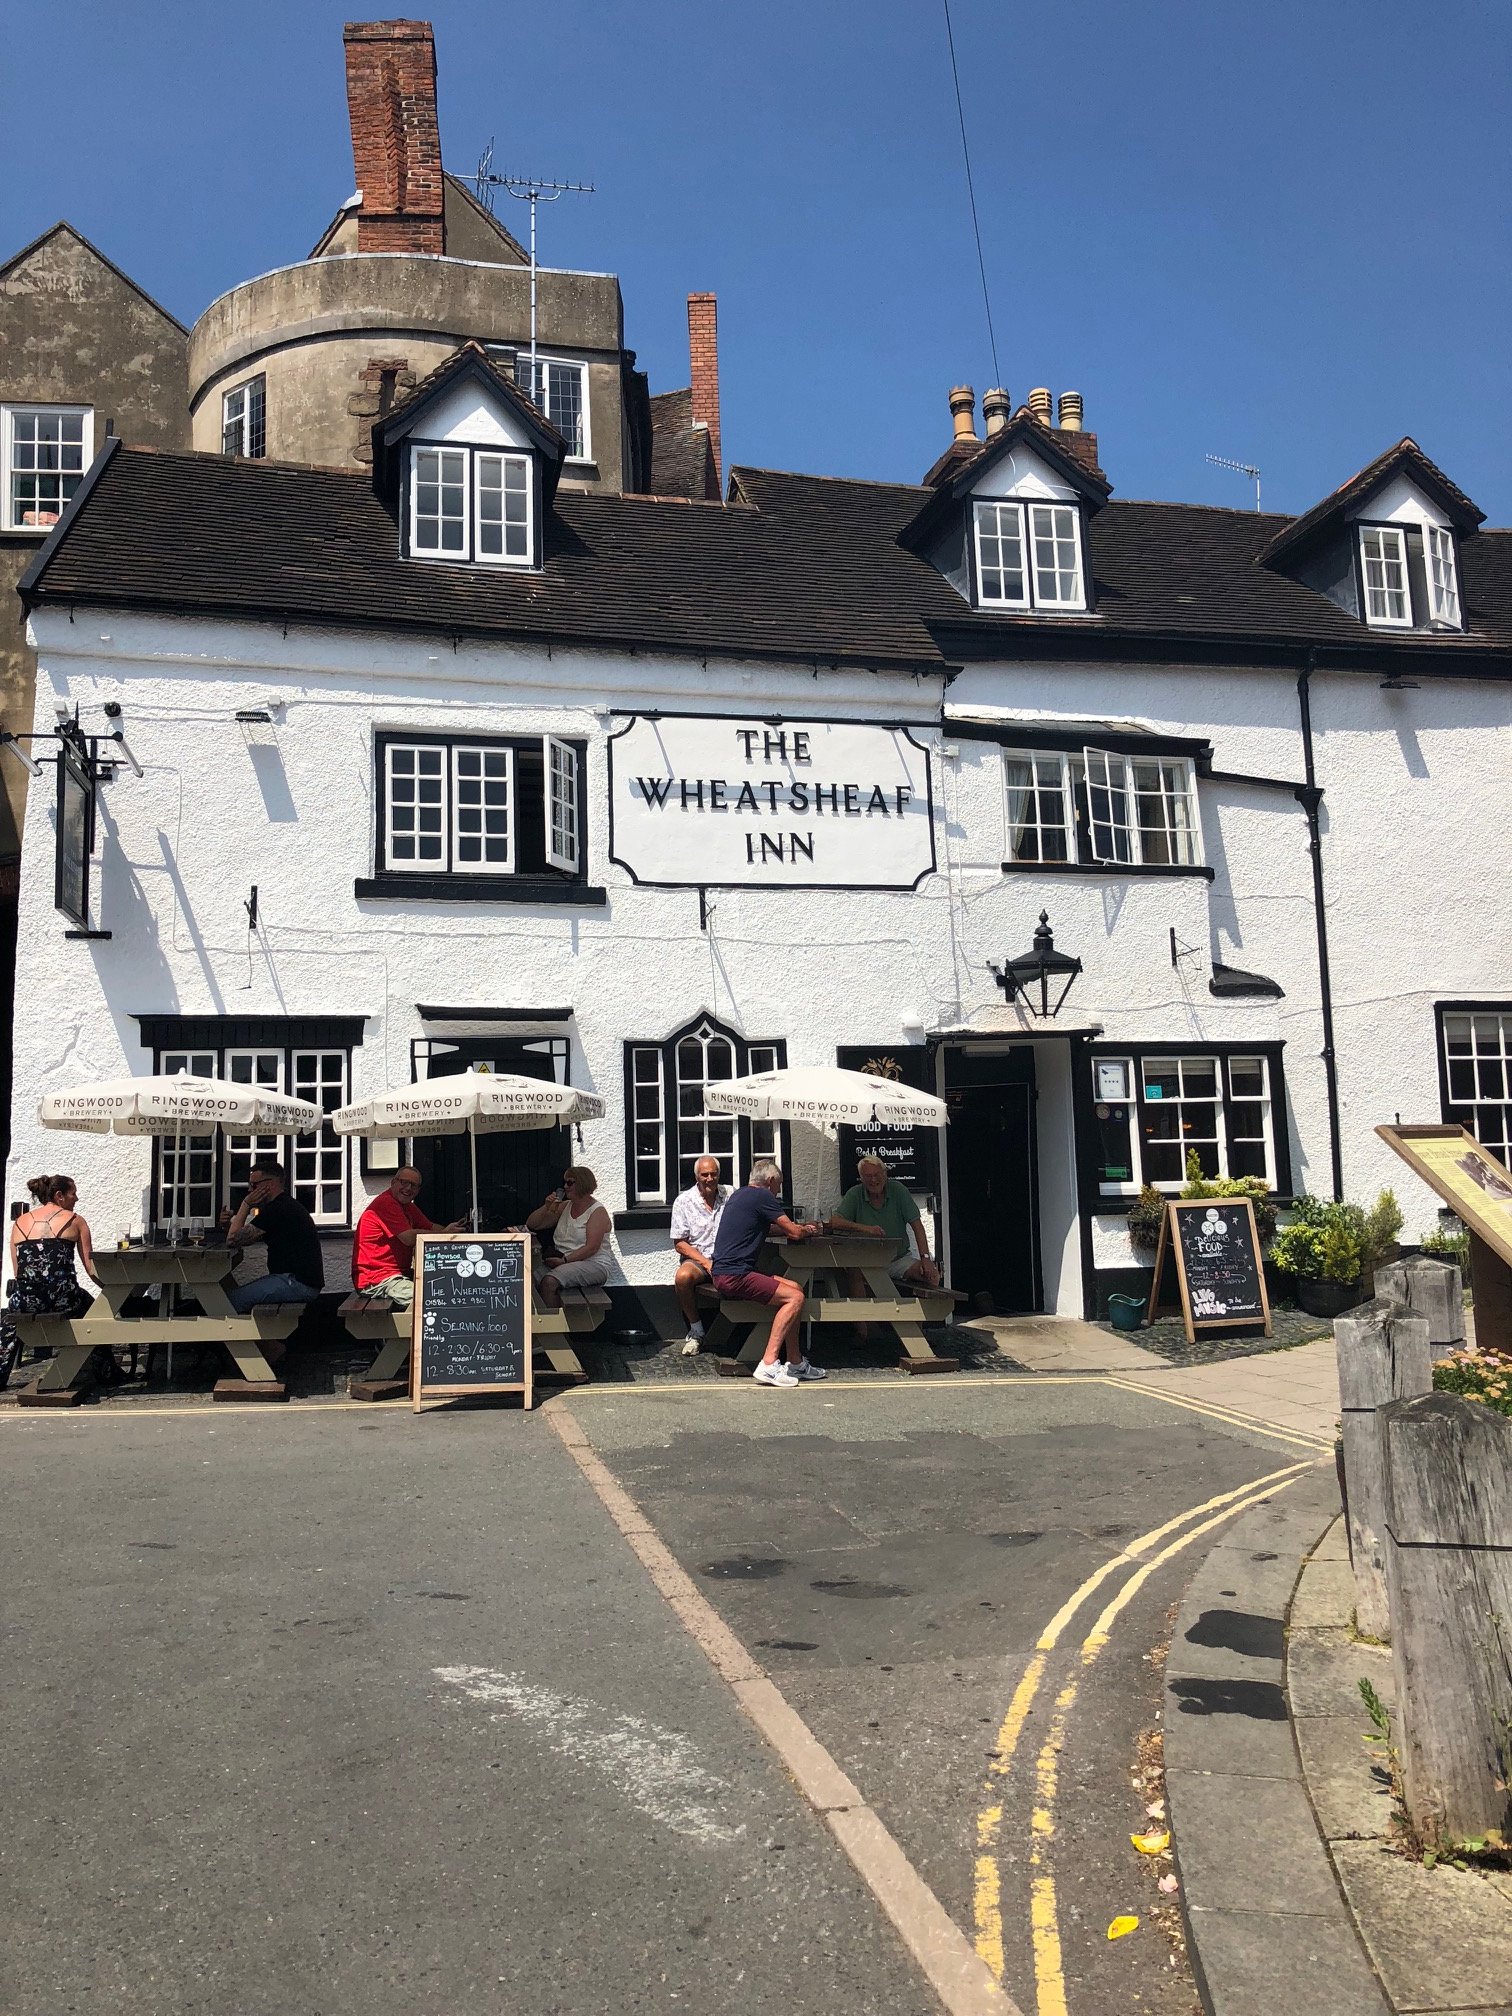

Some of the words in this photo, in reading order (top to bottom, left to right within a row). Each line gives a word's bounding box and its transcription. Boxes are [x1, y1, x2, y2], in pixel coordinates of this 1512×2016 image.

[735, 729, 811, 761] THE
[636, 776, 912, 814] WHEATSHEAF
[745, 832, 814, 864] INN
[53, 1097, 124, 1109] RINGWOOD
[151, 1095, 239, 1111] RINGWOOD
[385, 1097, 462, 1113] RINGWOOD
[492, 1093, 564, 1103] RINGWOOD
[710, 1092, 759, 1108] RINGWOOD
[171, 1109, 217, 1118] BREWERY
[266, 1103, 315, 1118] RINGWOOD
[337, 1106, 368, 1121] RINGWOOD
[782, 1100, 859, 1114] RINGWOOD
[884, 1105, 937, 1117] RINGWOOD
[404, 1111, 445, 1120] BREWERY
[799, 1111, 840, 1120] BREWERY
[856, 1147, 870, 1157] Bed
[872, 1147, 878, 1157] &
[879, 1146, 914, 1160] Breakfast
[1194, 1234, 1231, 1243] Delicious
[1198, 1242, 1223, 1252] FOOD
[427, 1276, 446, 1296] THE
[451, 1277, 511, 1296] WHEATSHEAF
[490, 1295, 518, 1310] INN
[424, 1325, 435, 1334] Dog
[424, 1333, 445, 1343] Friendly
